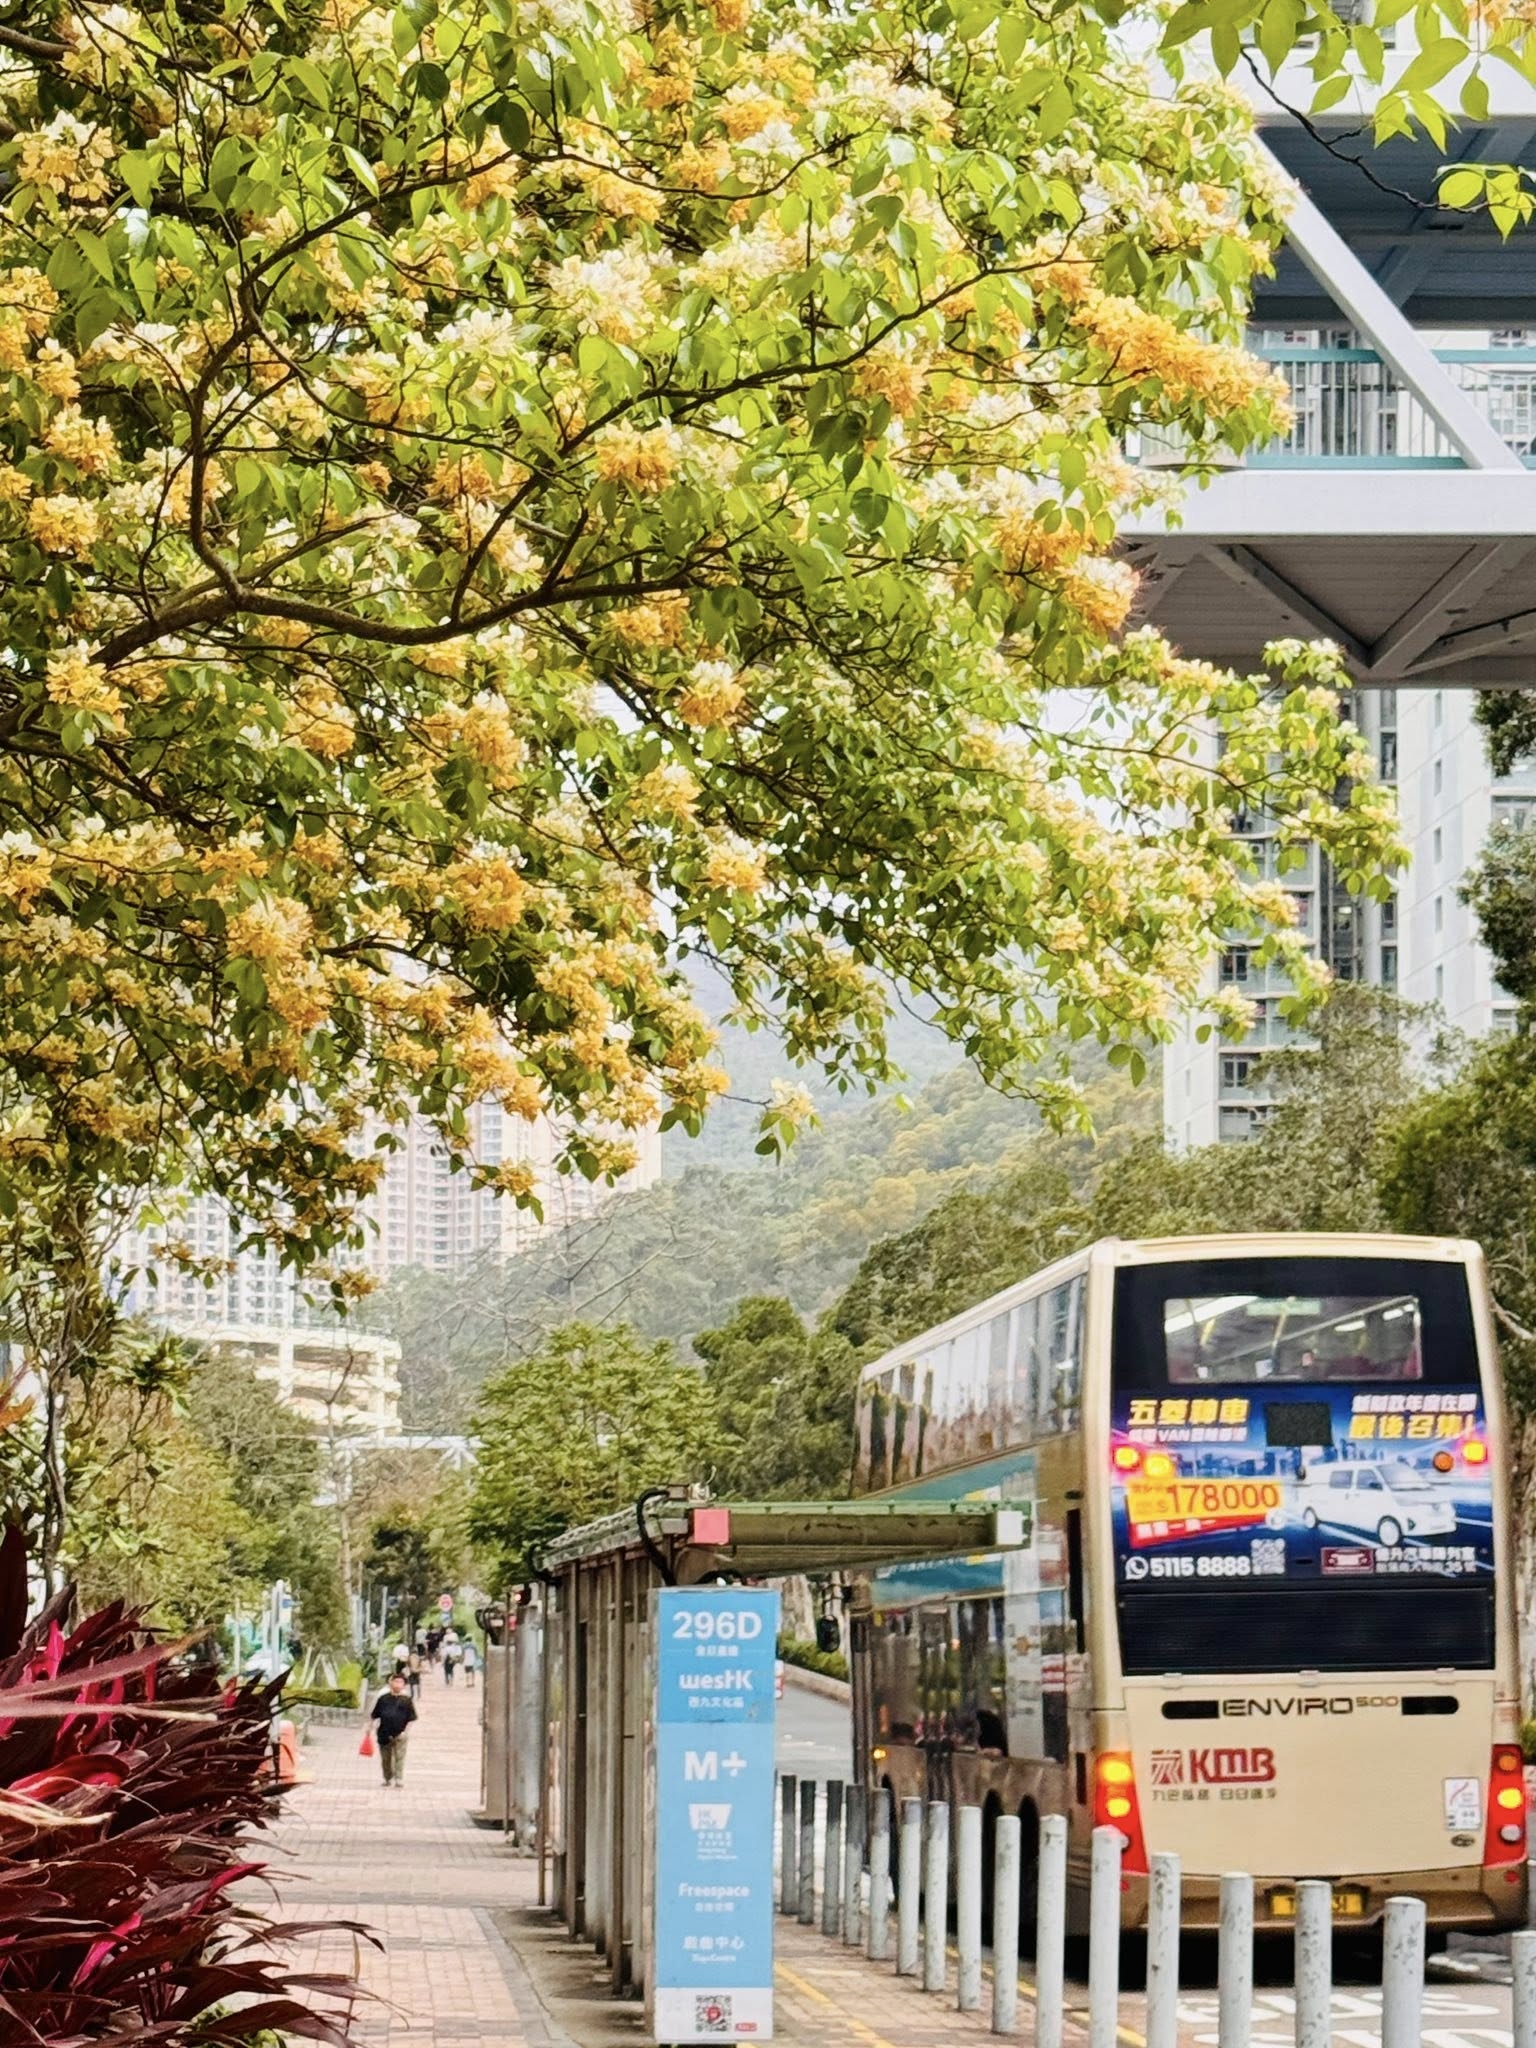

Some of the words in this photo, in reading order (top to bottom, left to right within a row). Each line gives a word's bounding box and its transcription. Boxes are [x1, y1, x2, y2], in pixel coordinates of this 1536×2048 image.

[1150, 1557, 1195, 1577] 5115
[1197, 1556, 1250, 1576] 8888
[672, 1611, 762, 1639] 296D
[684, 1750, 748, 1780] M+
[1189, 1748, 1276, 1783] KMB
[678, 1882, 750, 1898] Freespace
